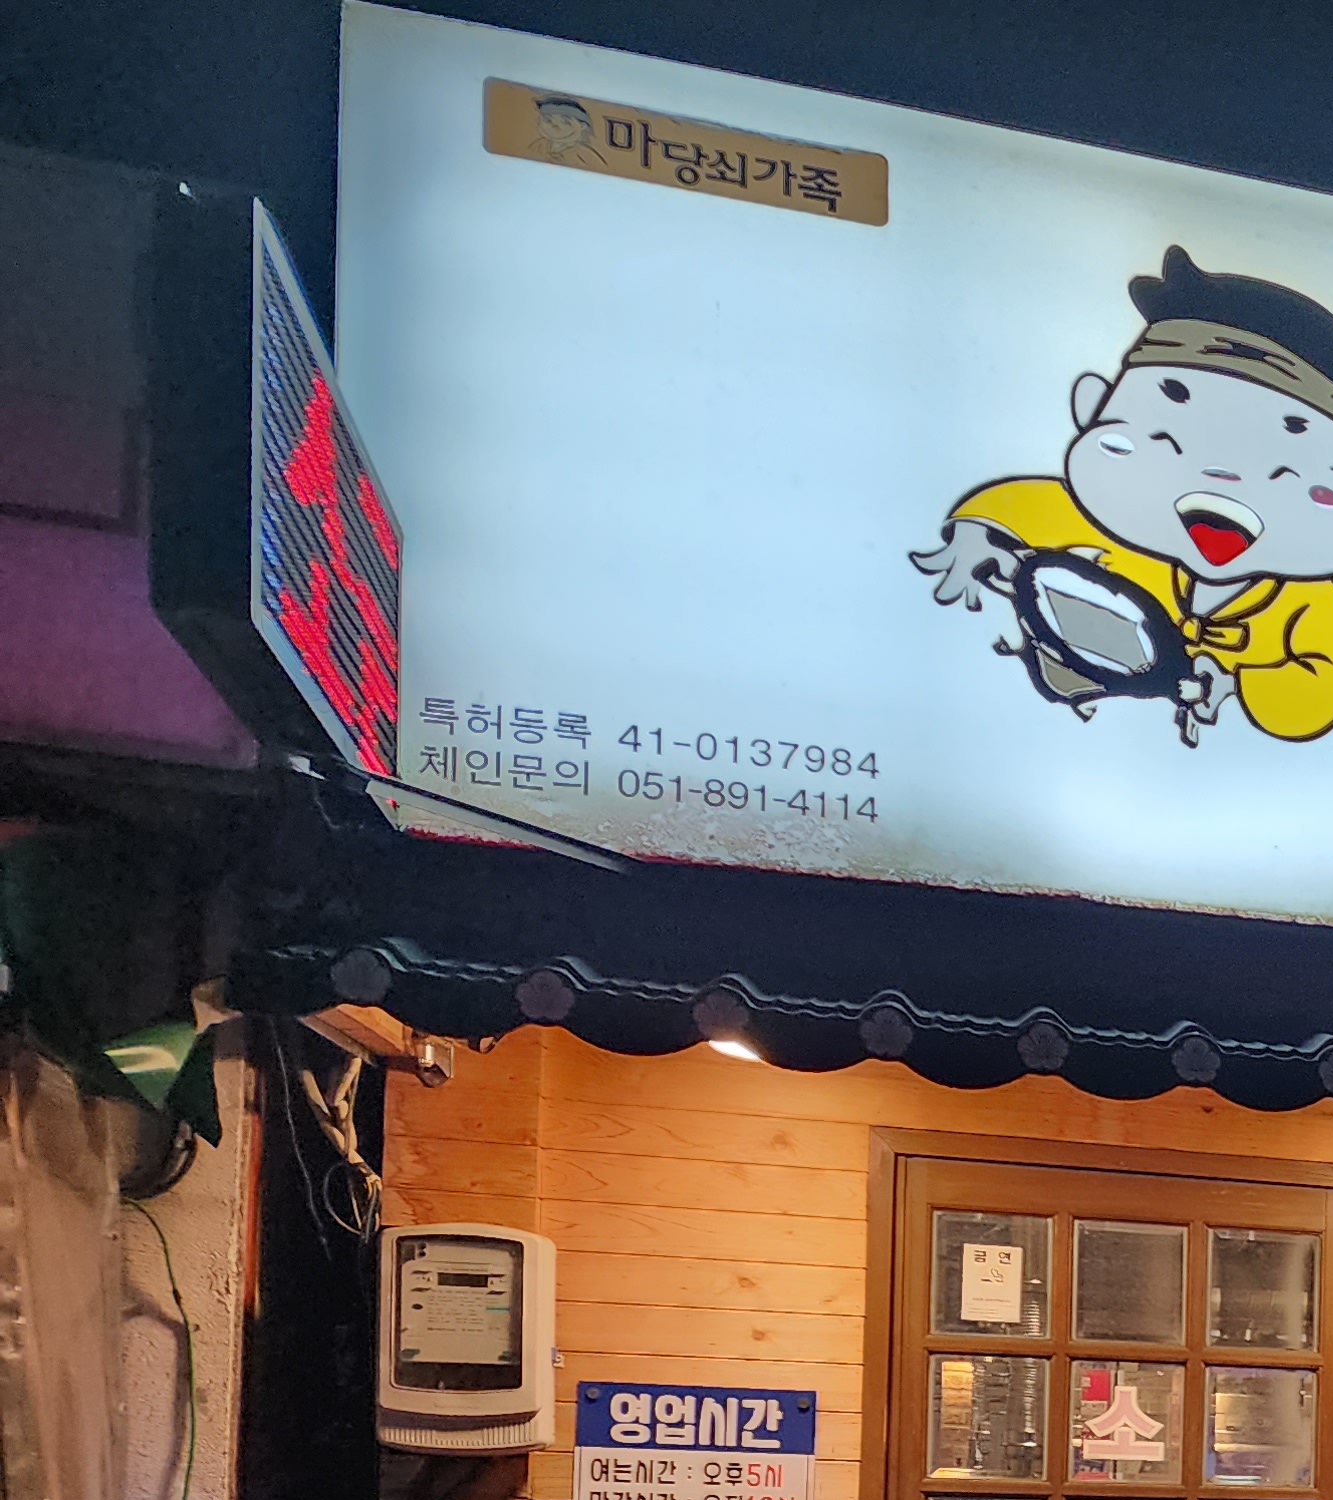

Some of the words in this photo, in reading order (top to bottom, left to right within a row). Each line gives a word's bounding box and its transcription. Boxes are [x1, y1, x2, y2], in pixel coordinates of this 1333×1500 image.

[603, 116, 843, 213] 마당쇠가족
[419, 696, 592, 749] 특허등록
[618, 724, 881, 779] 41-0137984
[420, 747, 590, 796] 체인문의
[618, 769, 879, 823] 051-891-4114
[610, 1393, 783, 1449] 영업시간
[590, 1458, 676, 1484] 여는시간
